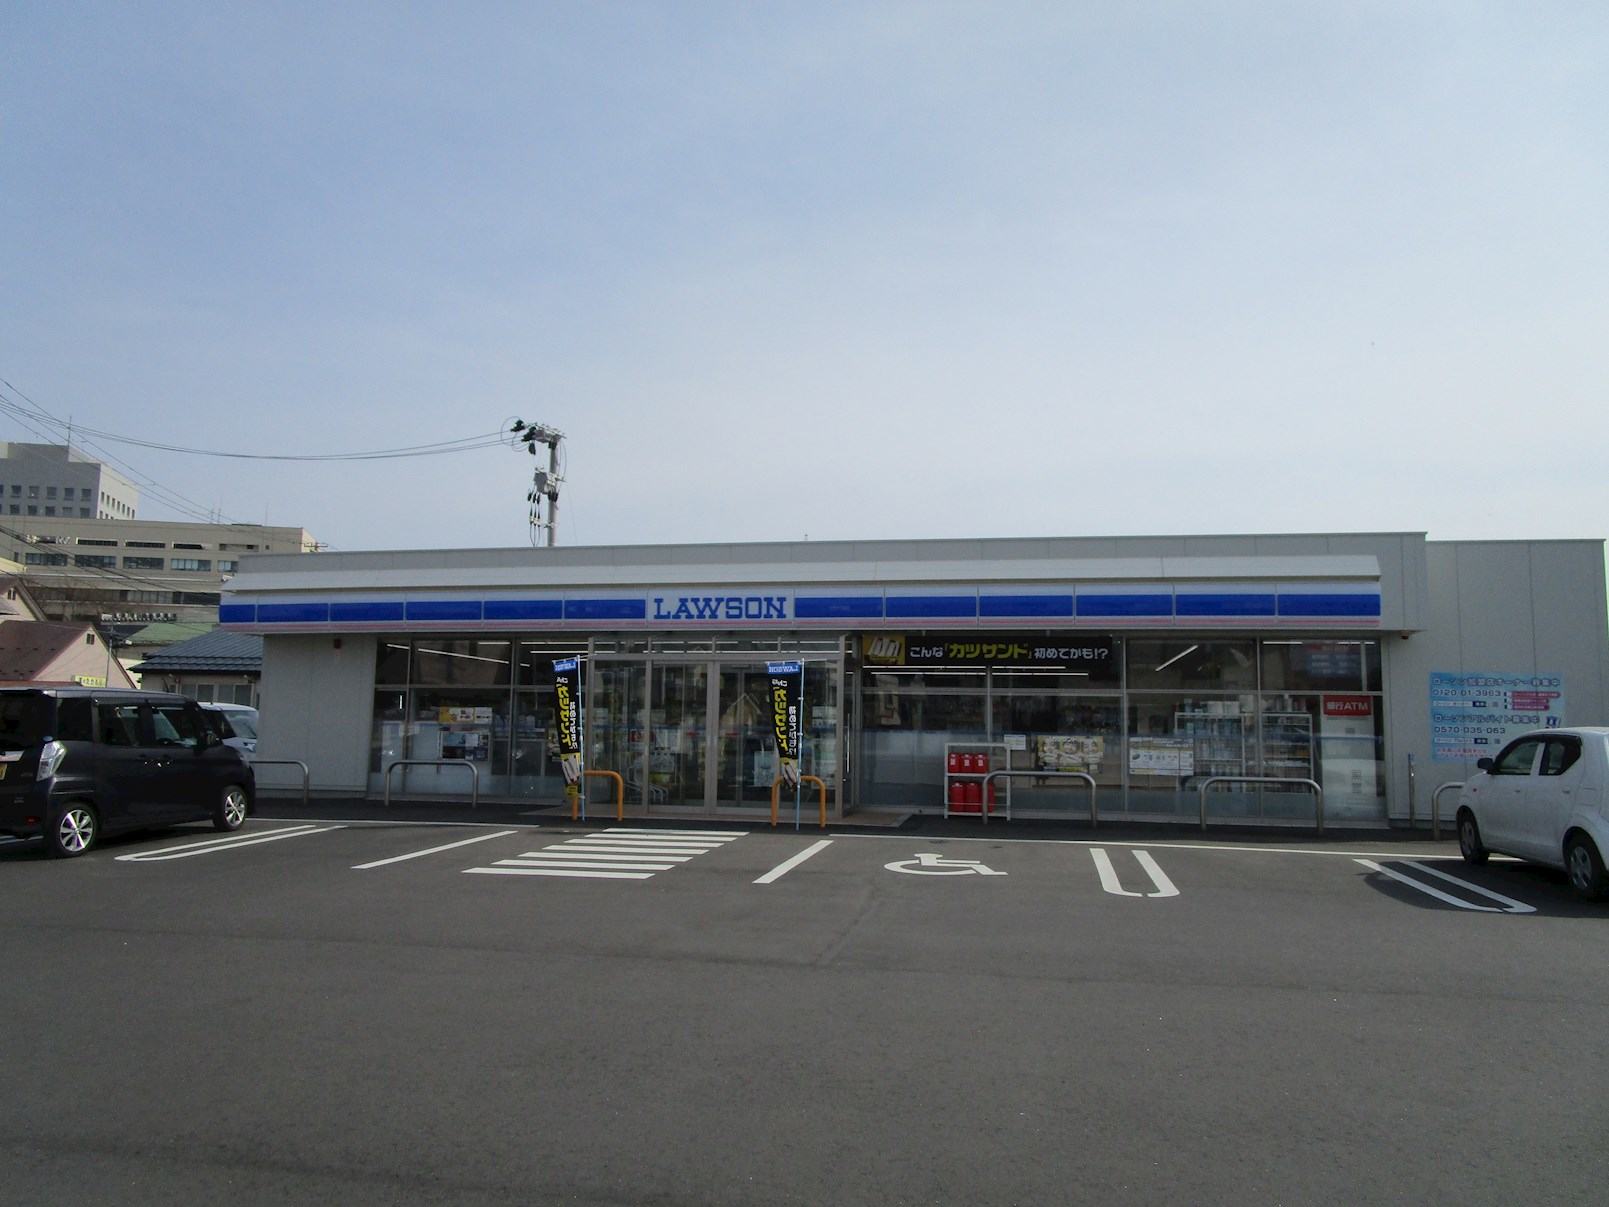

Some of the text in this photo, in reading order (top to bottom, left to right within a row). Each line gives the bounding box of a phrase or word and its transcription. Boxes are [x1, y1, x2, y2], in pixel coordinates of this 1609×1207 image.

[653, 597, 787, 619] LAWSON
[1434, 713, 1540, 724] ローソンアルバイト募集中
